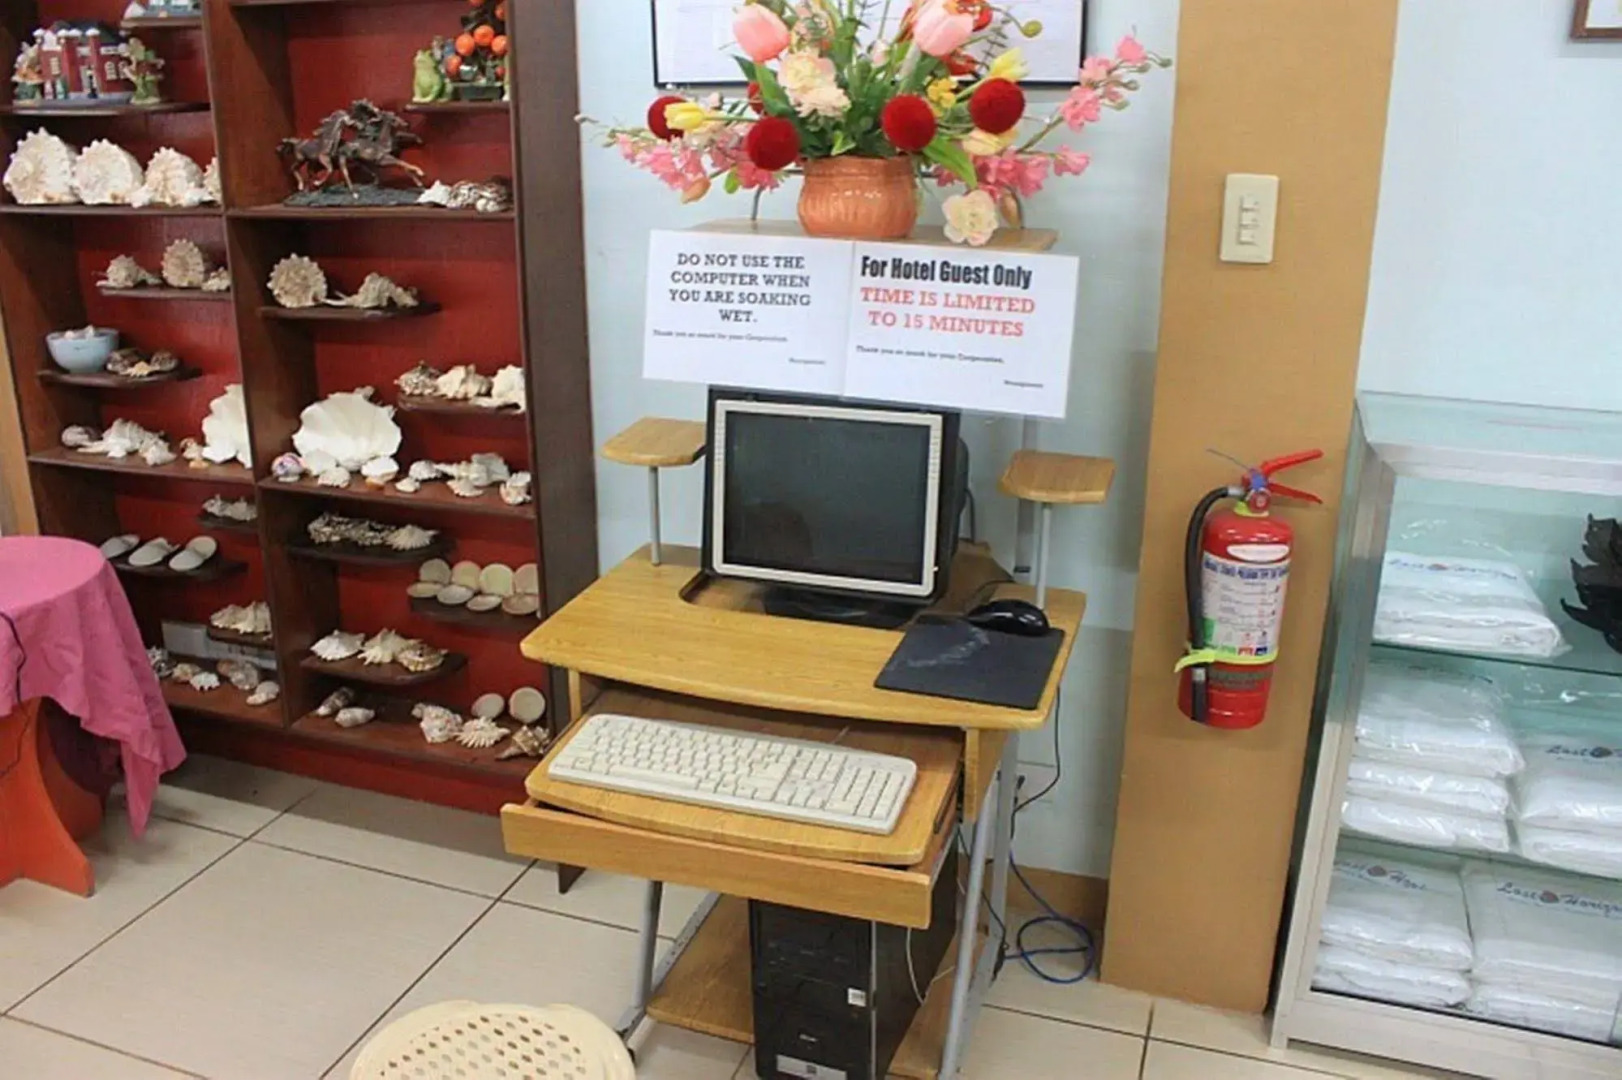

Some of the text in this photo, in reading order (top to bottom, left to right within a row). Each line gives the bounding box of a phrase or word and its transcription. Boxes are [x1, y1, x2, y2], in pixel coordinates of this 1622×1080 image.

[677, 253, 805, 269] DO NOT USE THE
[670, 271, 810, 288] COMPUTER WHEN
[861, 255, 1033, 290] For Hotel Guest Only
[669, 289, 811, 306] YOU ARE SOAKING
[860, 286, 1035, 314] TIME IS LIMITED
[719, 308, 758, 323] WET.
[868, 310, 1024, 337] TO 15 MINUTES
